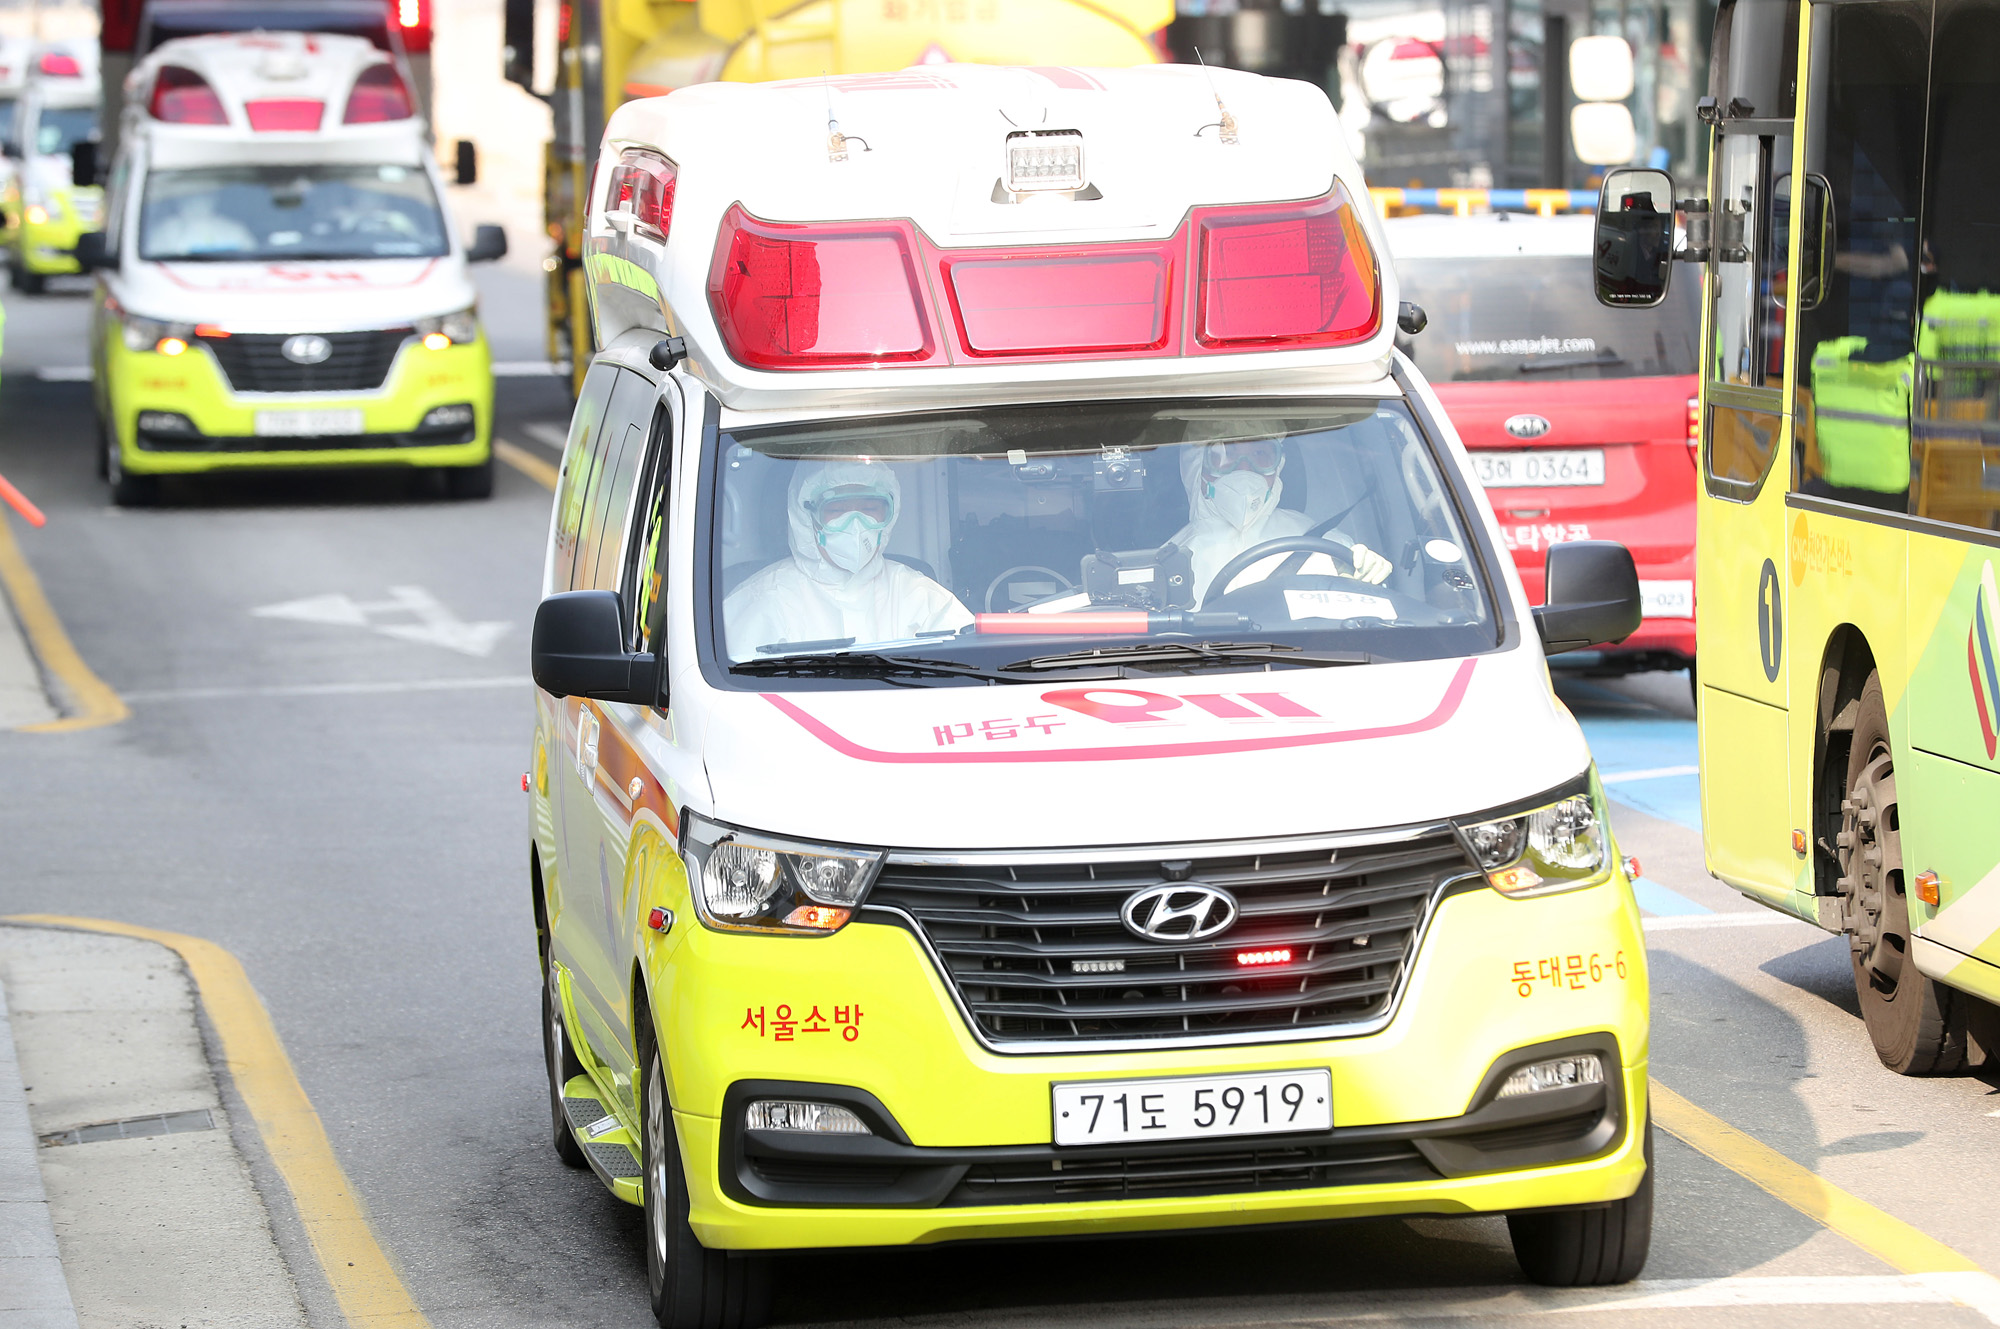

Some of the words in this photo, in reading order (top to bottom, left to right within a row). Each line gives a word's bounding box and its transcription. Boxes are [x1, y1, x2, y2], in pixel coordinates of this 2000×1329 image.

[1526, 455, 1588, 480] 0364
[1793, 534, 1808, 564] CNG
[1764, 574, 1775, 668] 1
[1511, 950, 1627, 998] 동대문6-6
[741, 1003, 864, 1042] 서울소방
[1080, 1093, 1167, 1134] 71도
[1193, 1083, 1304, 1128] 5919
